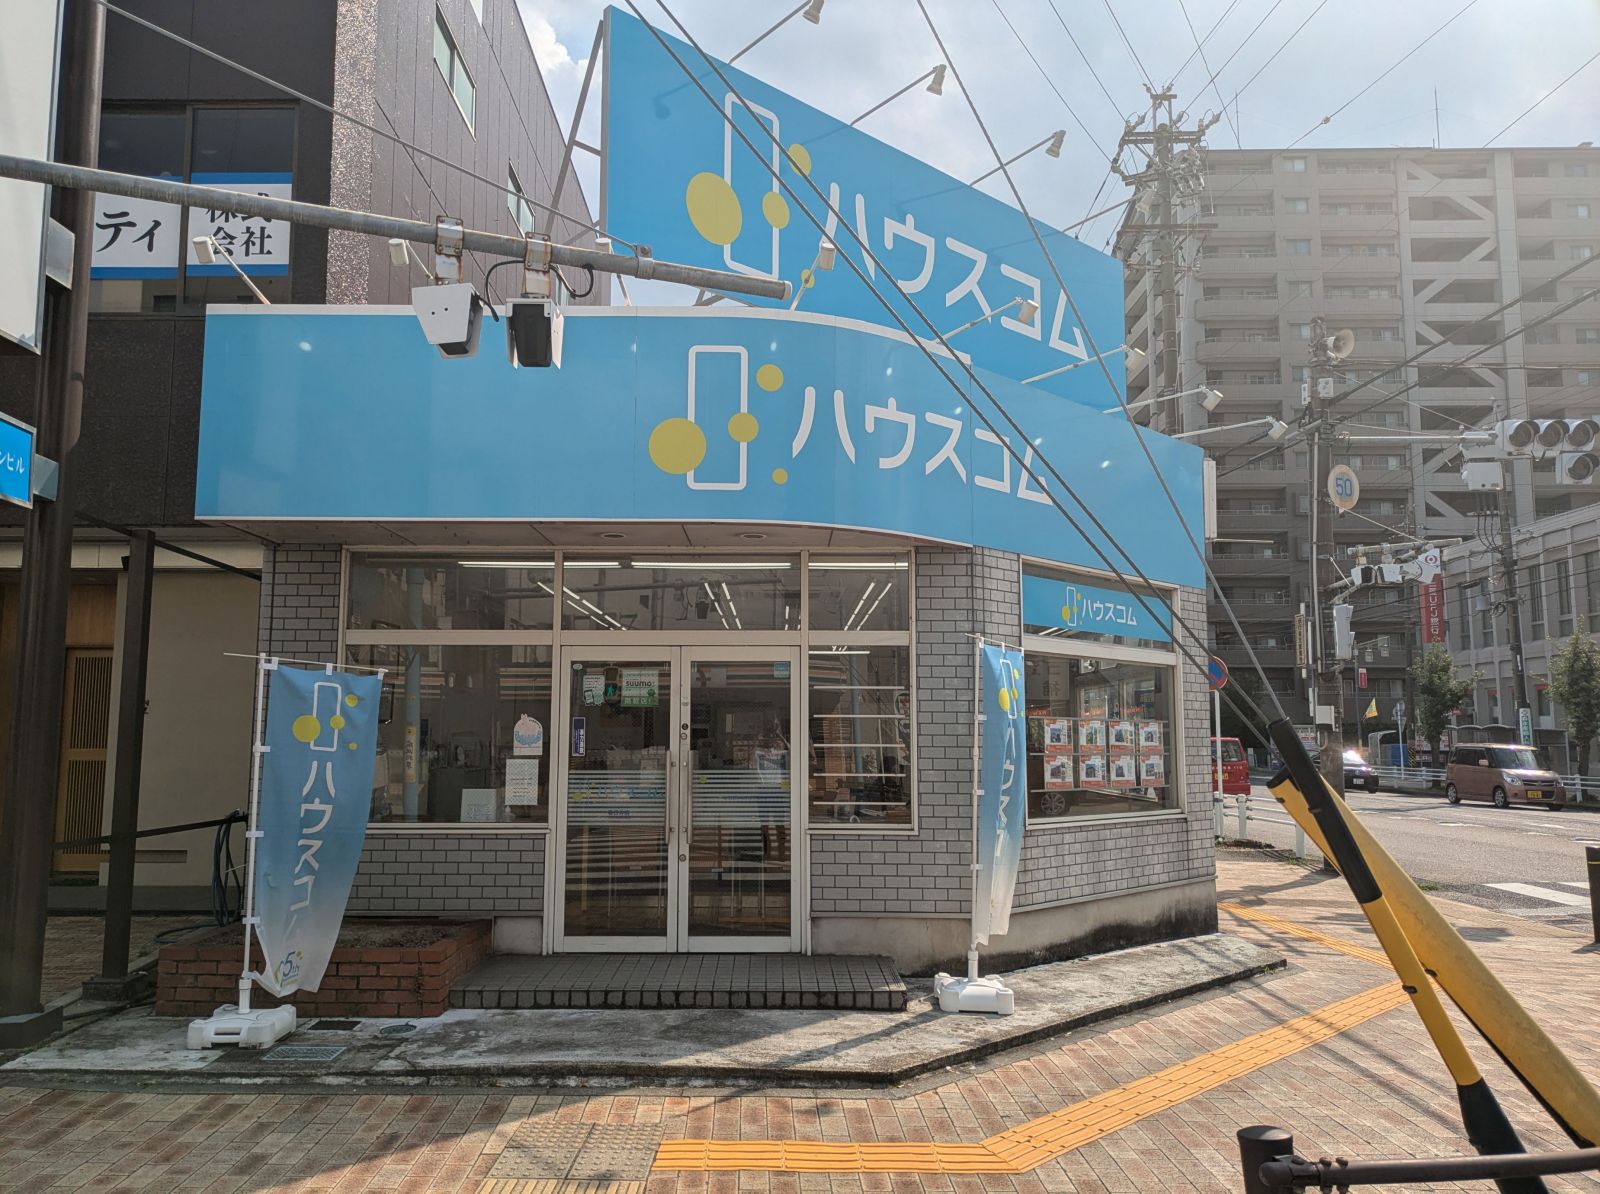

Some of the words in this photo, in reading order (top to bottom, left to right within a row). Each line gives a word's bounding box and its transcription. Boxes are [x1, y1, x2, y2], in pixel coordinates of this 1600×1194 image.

[95, 211, 162, 253] ティ
[822, 181, 1089, 361] ハウスコム
[792, 386, 1053, 506] ハウスコム
[1336, 477, 1353, 497] 50
[1081, 597, 1138, 627] ハウスコム
